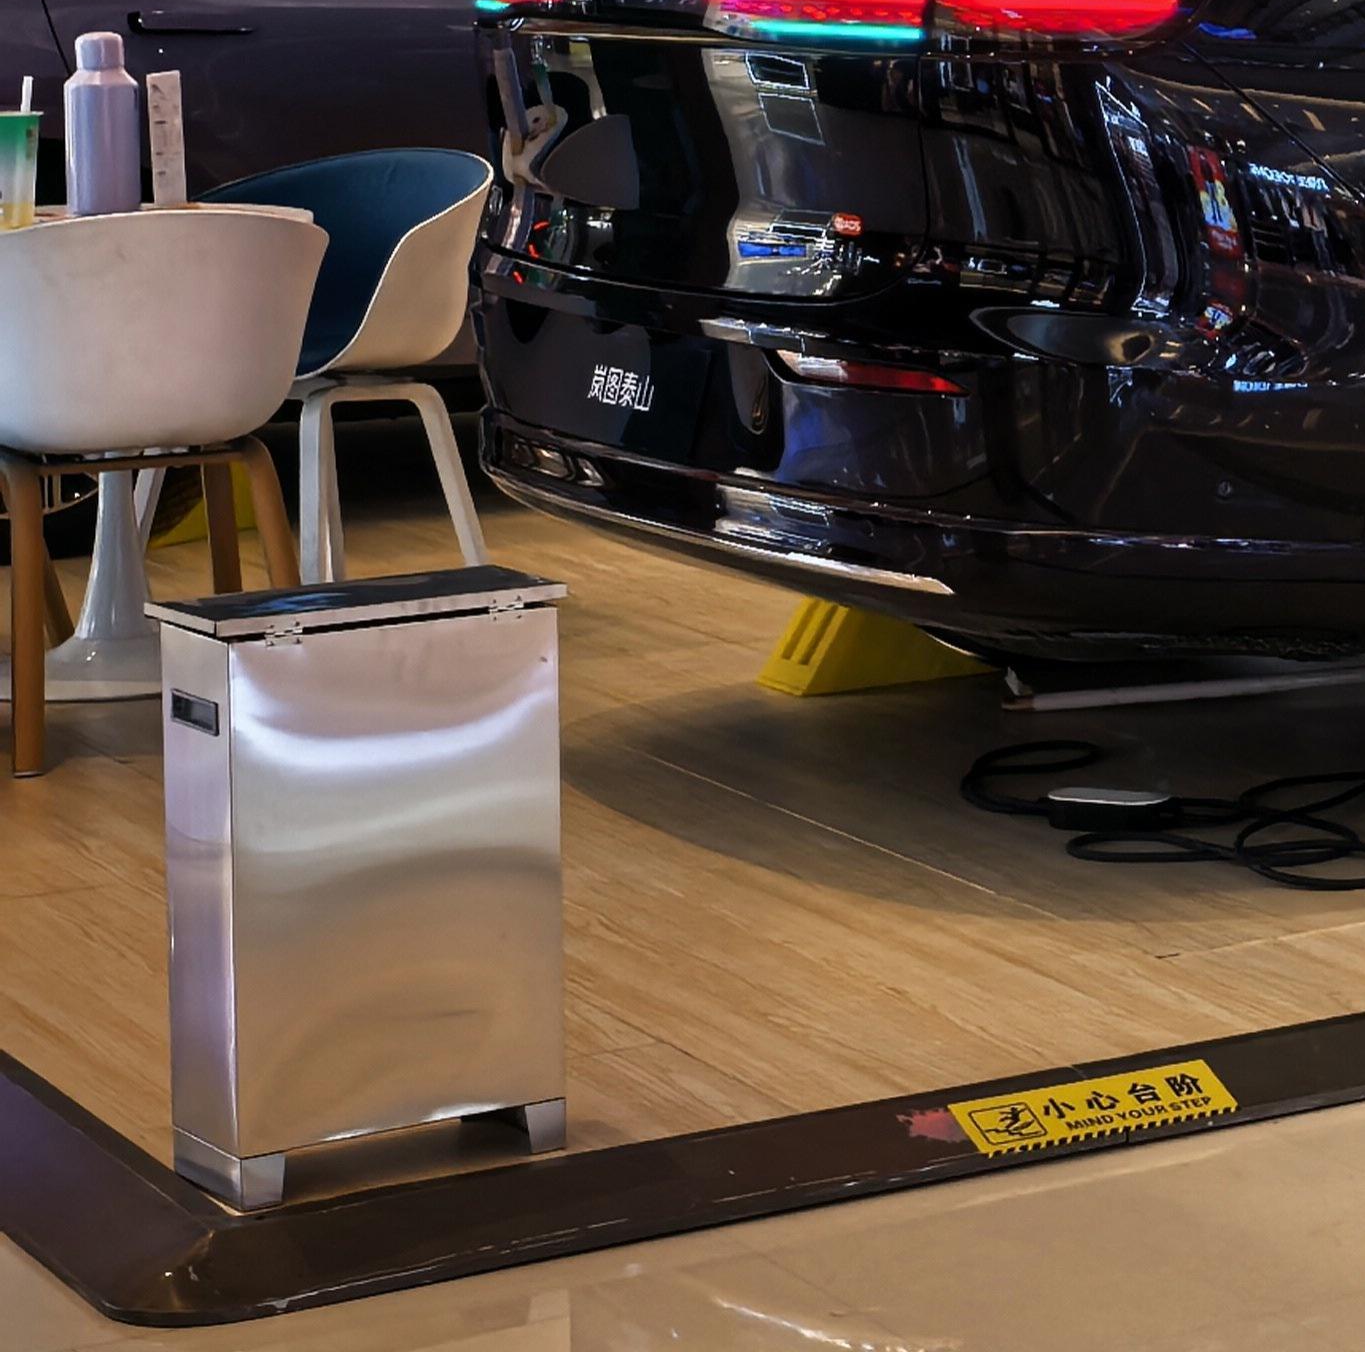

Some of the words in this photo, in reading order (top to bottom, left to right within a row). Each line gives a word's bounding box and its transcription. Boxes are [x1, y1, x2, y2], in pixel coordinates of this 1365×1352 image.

[587, 364, 654, 411] 岚图泰山
[1043, 1073, 1203, 1119] 小心台阶
[1066, 1113, 1115, 1132] MIND
[1115, 1103, 1169, 1121] YOUR
[1168, 1095, 1212, 1112] STEP
